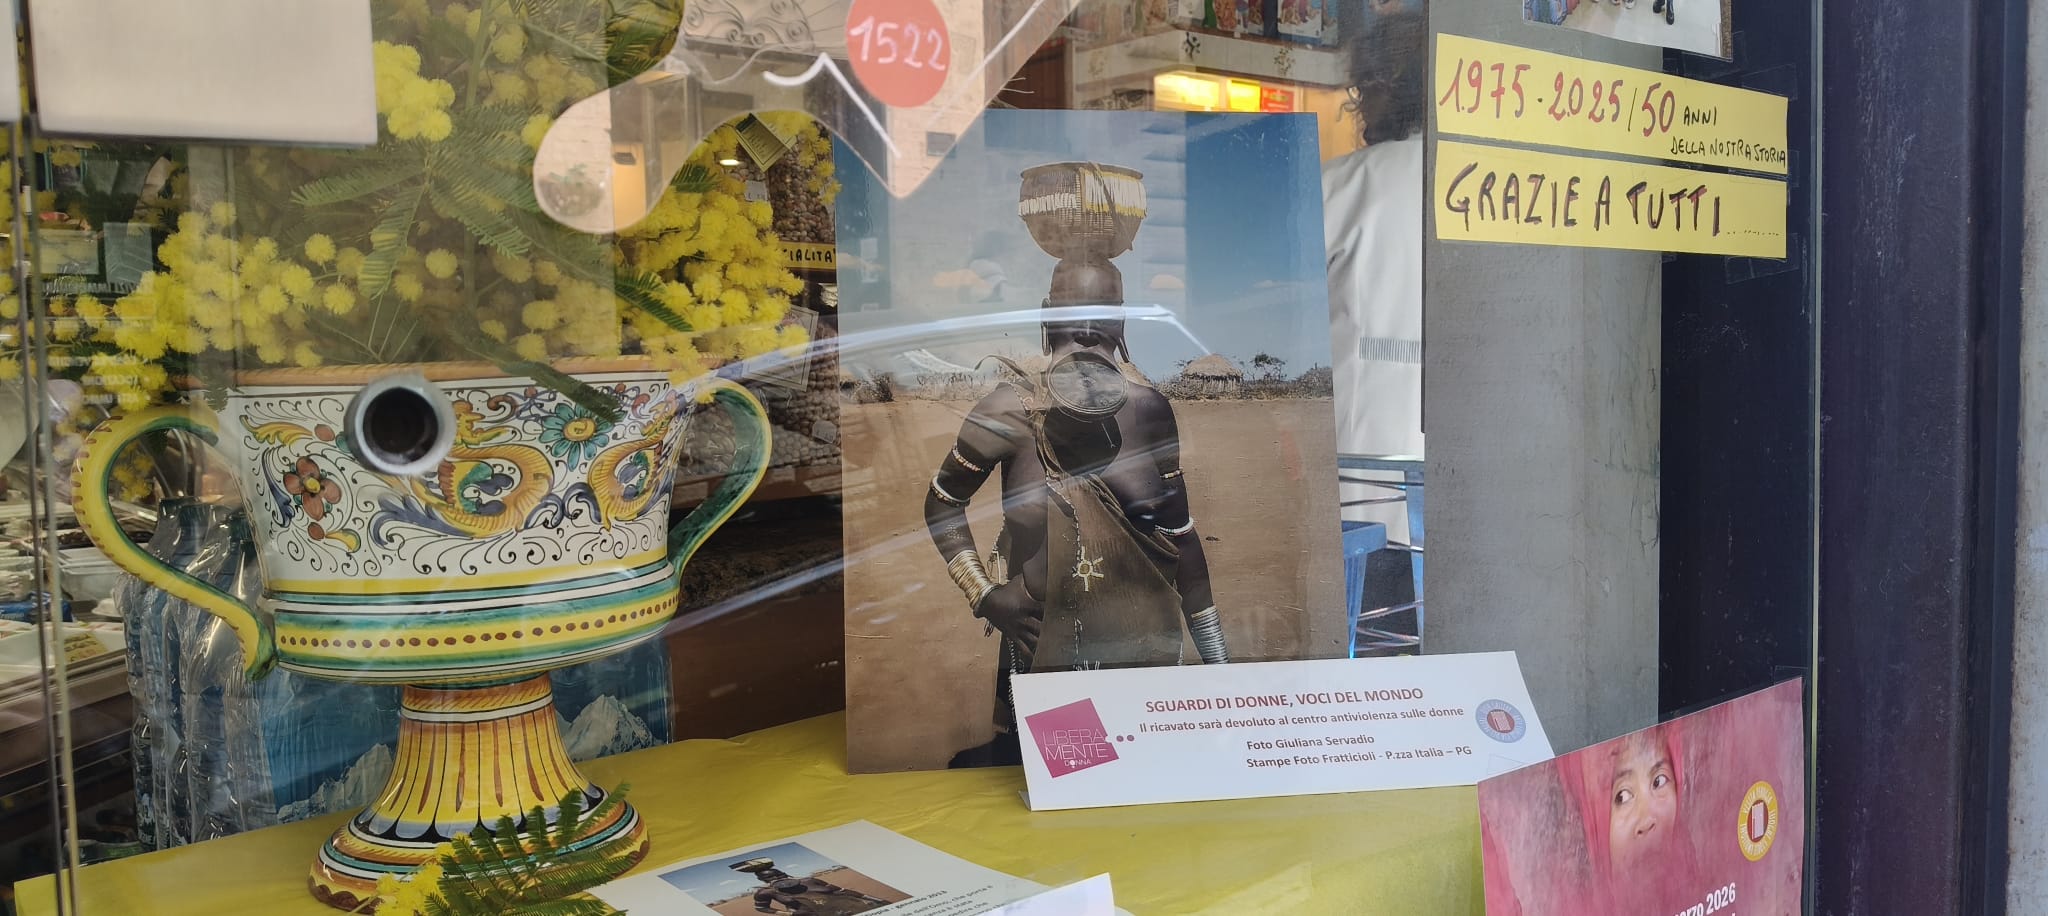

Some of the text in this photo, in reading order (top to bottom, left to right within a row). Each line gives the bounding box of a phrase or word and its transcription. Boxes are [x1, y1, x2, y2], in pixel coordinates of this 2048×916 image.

[849, 16, 946, 71] 1522
[1683, 106, 1717, 126] ANNI
[1671, 136, 1786, 168] DELLA NOSTRA STORIA
[1445, 162, 1581, 232] GRAZIE
[1593, 175, 1611, 232] A
[783, 248, 835, 263] IALITA'
[1145, 688, 1424, 713] SGUARDI DI DONNE, VOCI DEL MONDO
[1139, 705, 1465, 733] Il ricavato sarà devoluto al centro antiviolenza sulle donne
[1042, 728, 1105, 746] LIBERA
[1246, 733, 1375, 751] Foto Giuliana Servadio
[1045, 742, 1109, 761] MENTE
[1246, 757, 1291, 769] Stampe
[1293, 753, 1320, 766] Foto
[1322, 750, 1376, 764] Fratticioli
[1385, 749, 1413, 761] P.zza
[1414, 746, 1445, 759] Italia
[1455, 744, 1473, 756] PG
[1706, 882, 1736, 915] 2026
